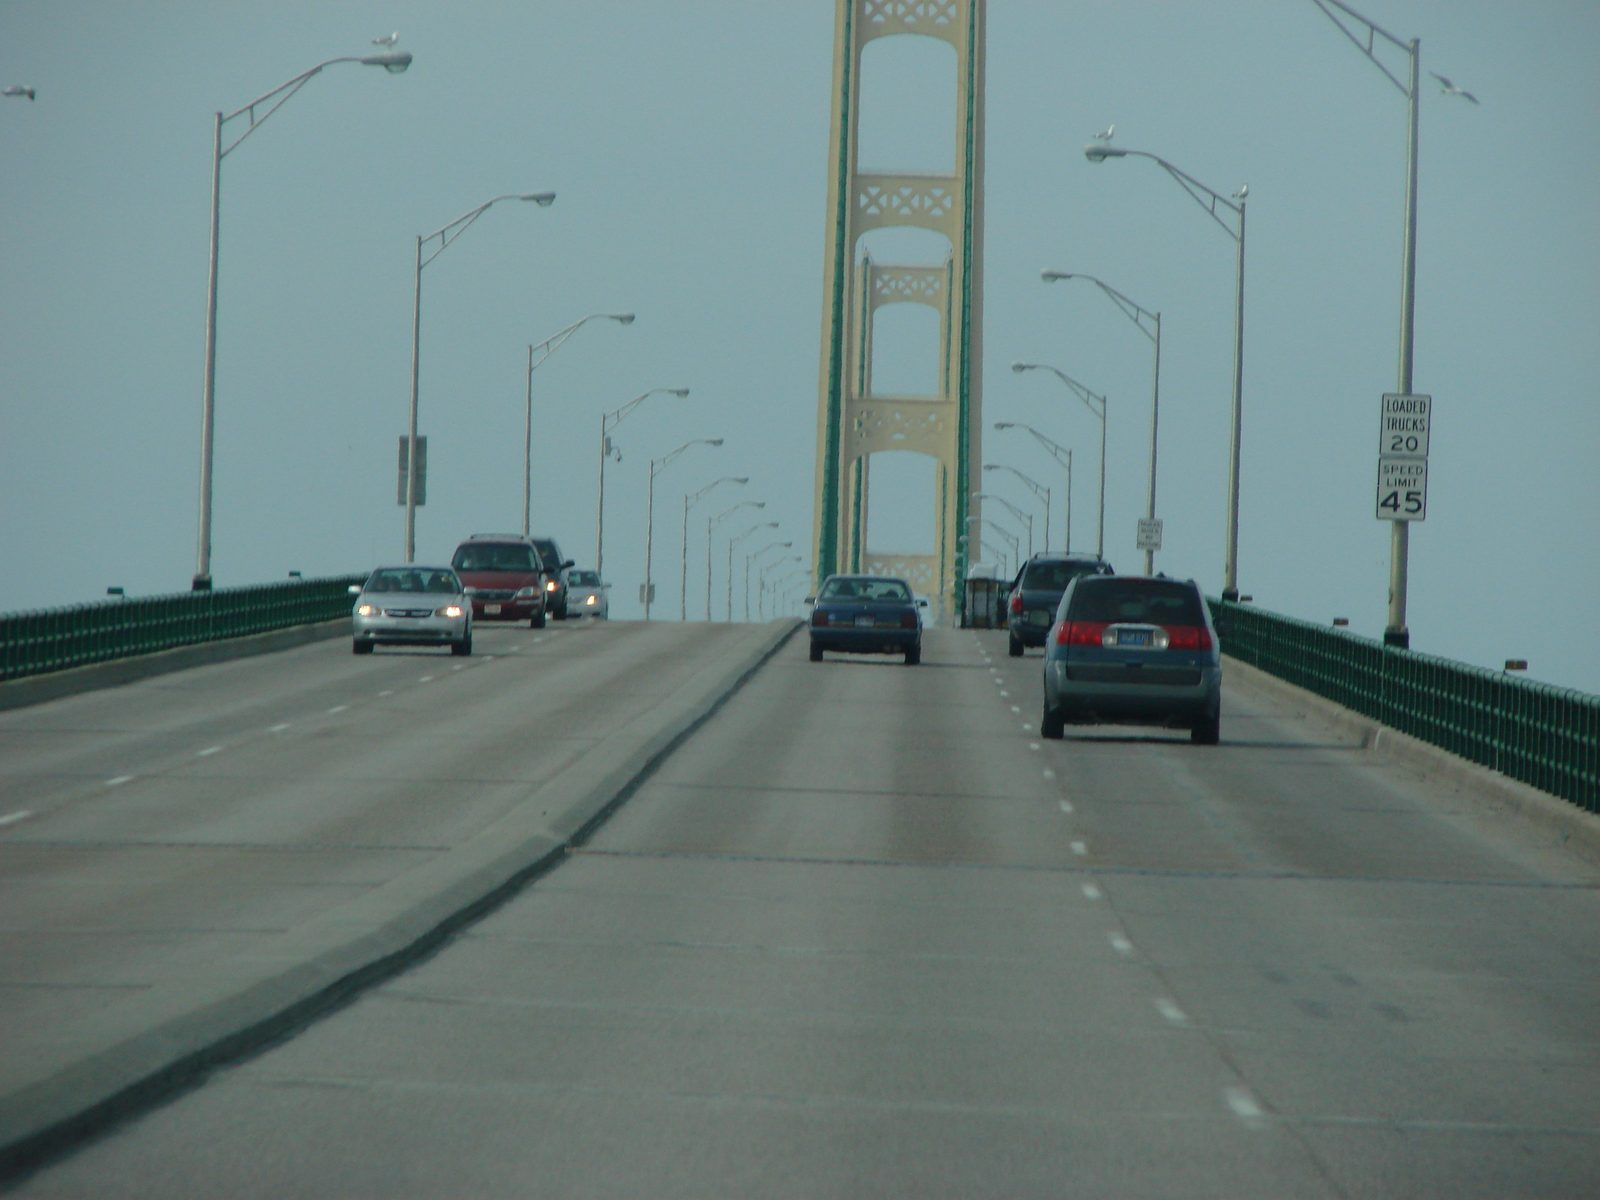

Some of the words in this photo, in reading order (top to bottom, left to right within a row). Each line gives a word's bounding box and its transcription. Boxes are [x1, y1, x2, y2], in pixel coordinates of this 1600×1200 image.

[1386, 399, 1426, 413] LOADED
[1387, 417, 1425, 432] TRUCKS
[1391, 435, 1418, 452] 20
[1383, 464, 1423, 475] SPEED
[1386, 478, 1418, 488] LIMIT
[1380, 490, 1422, 514] 45
